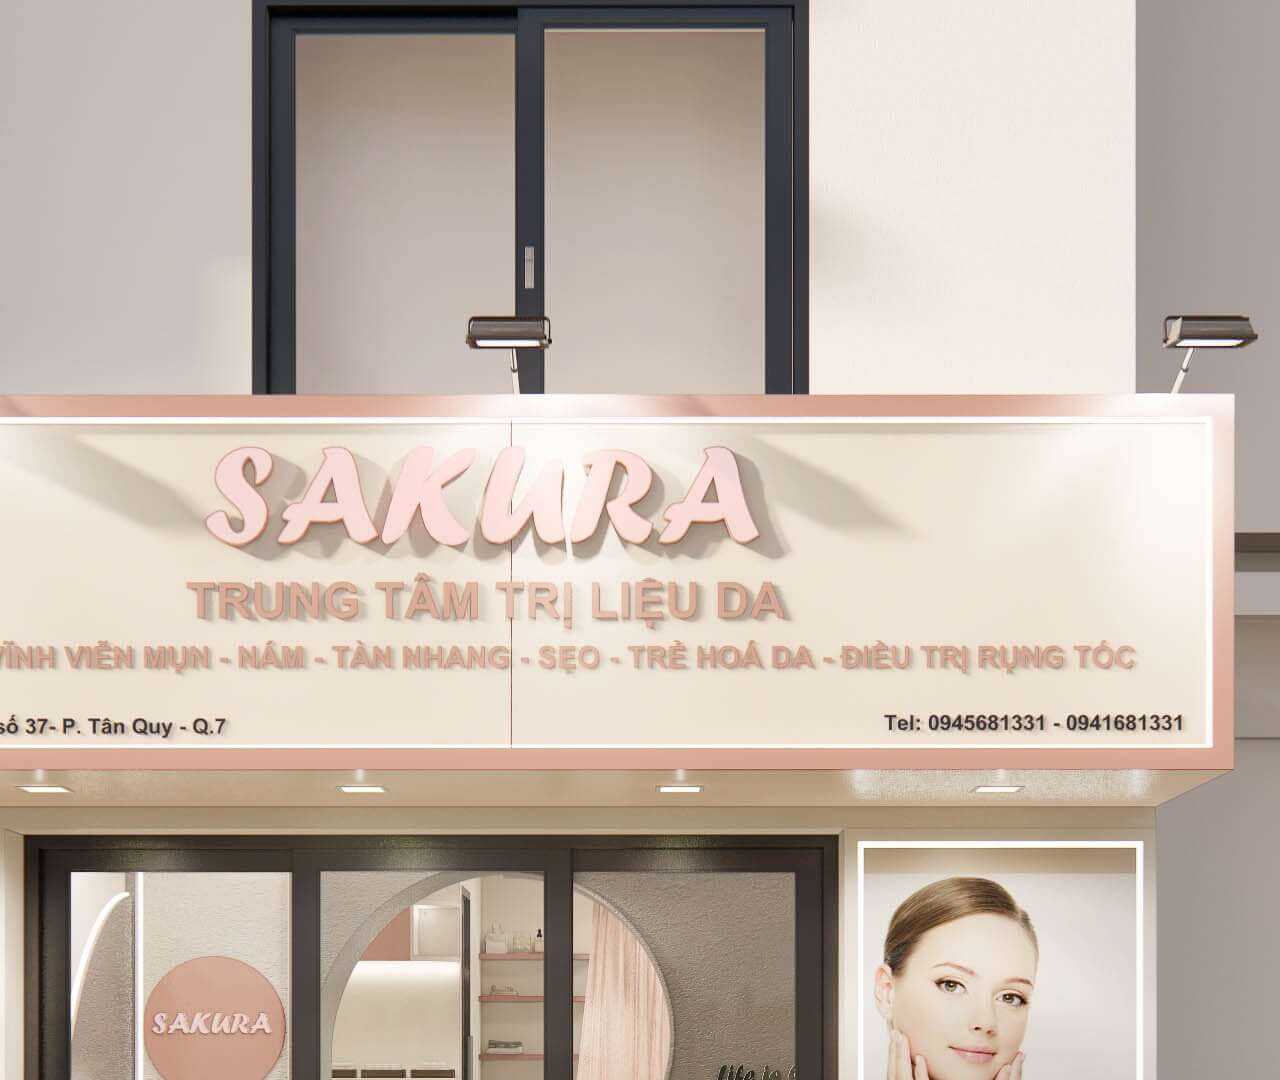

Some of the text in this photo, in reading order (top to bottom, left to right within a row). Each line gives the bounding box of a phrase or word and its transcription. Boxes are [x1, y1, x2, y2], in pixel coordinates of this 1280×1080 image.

[205, 446, 760, 547] SAKURA
[186, 571, 787, 630] TRUNG TÂM TRỊ LIỆU DA
[64, 640, 135, 670] VIỄN
[143, 645, 212, 675] MỤN
[237, 640, 307, 670] NÁM
[332, 640, 394, 670] TÀN
[402, 645, 511, 670] NHANG
[537, 645, 602, 675] SẸO
[628, 640, 689, 670] TRẺ
[696, 640, 764, 670] HOÁ
[771, 645, 816, 670] DA
[921, 645, 969, 674] TRỊ
[977, 645, 1065, 674] RỤNG
[1073, 640, 1137, 670] TÓC
[63, 718, 81, 735] P.
[88, 718, 125, 735] Tân
[132, 718, 173, 738] Quy
[193, 718, 226, 736] Q.7
[885, 714, 921, 731] Tel:
[927, 714, 1046, 731] 0945681331
[1066, 714, 1185, 731] 0941681331
[152, 1012, 273, 1034] SAKURA
